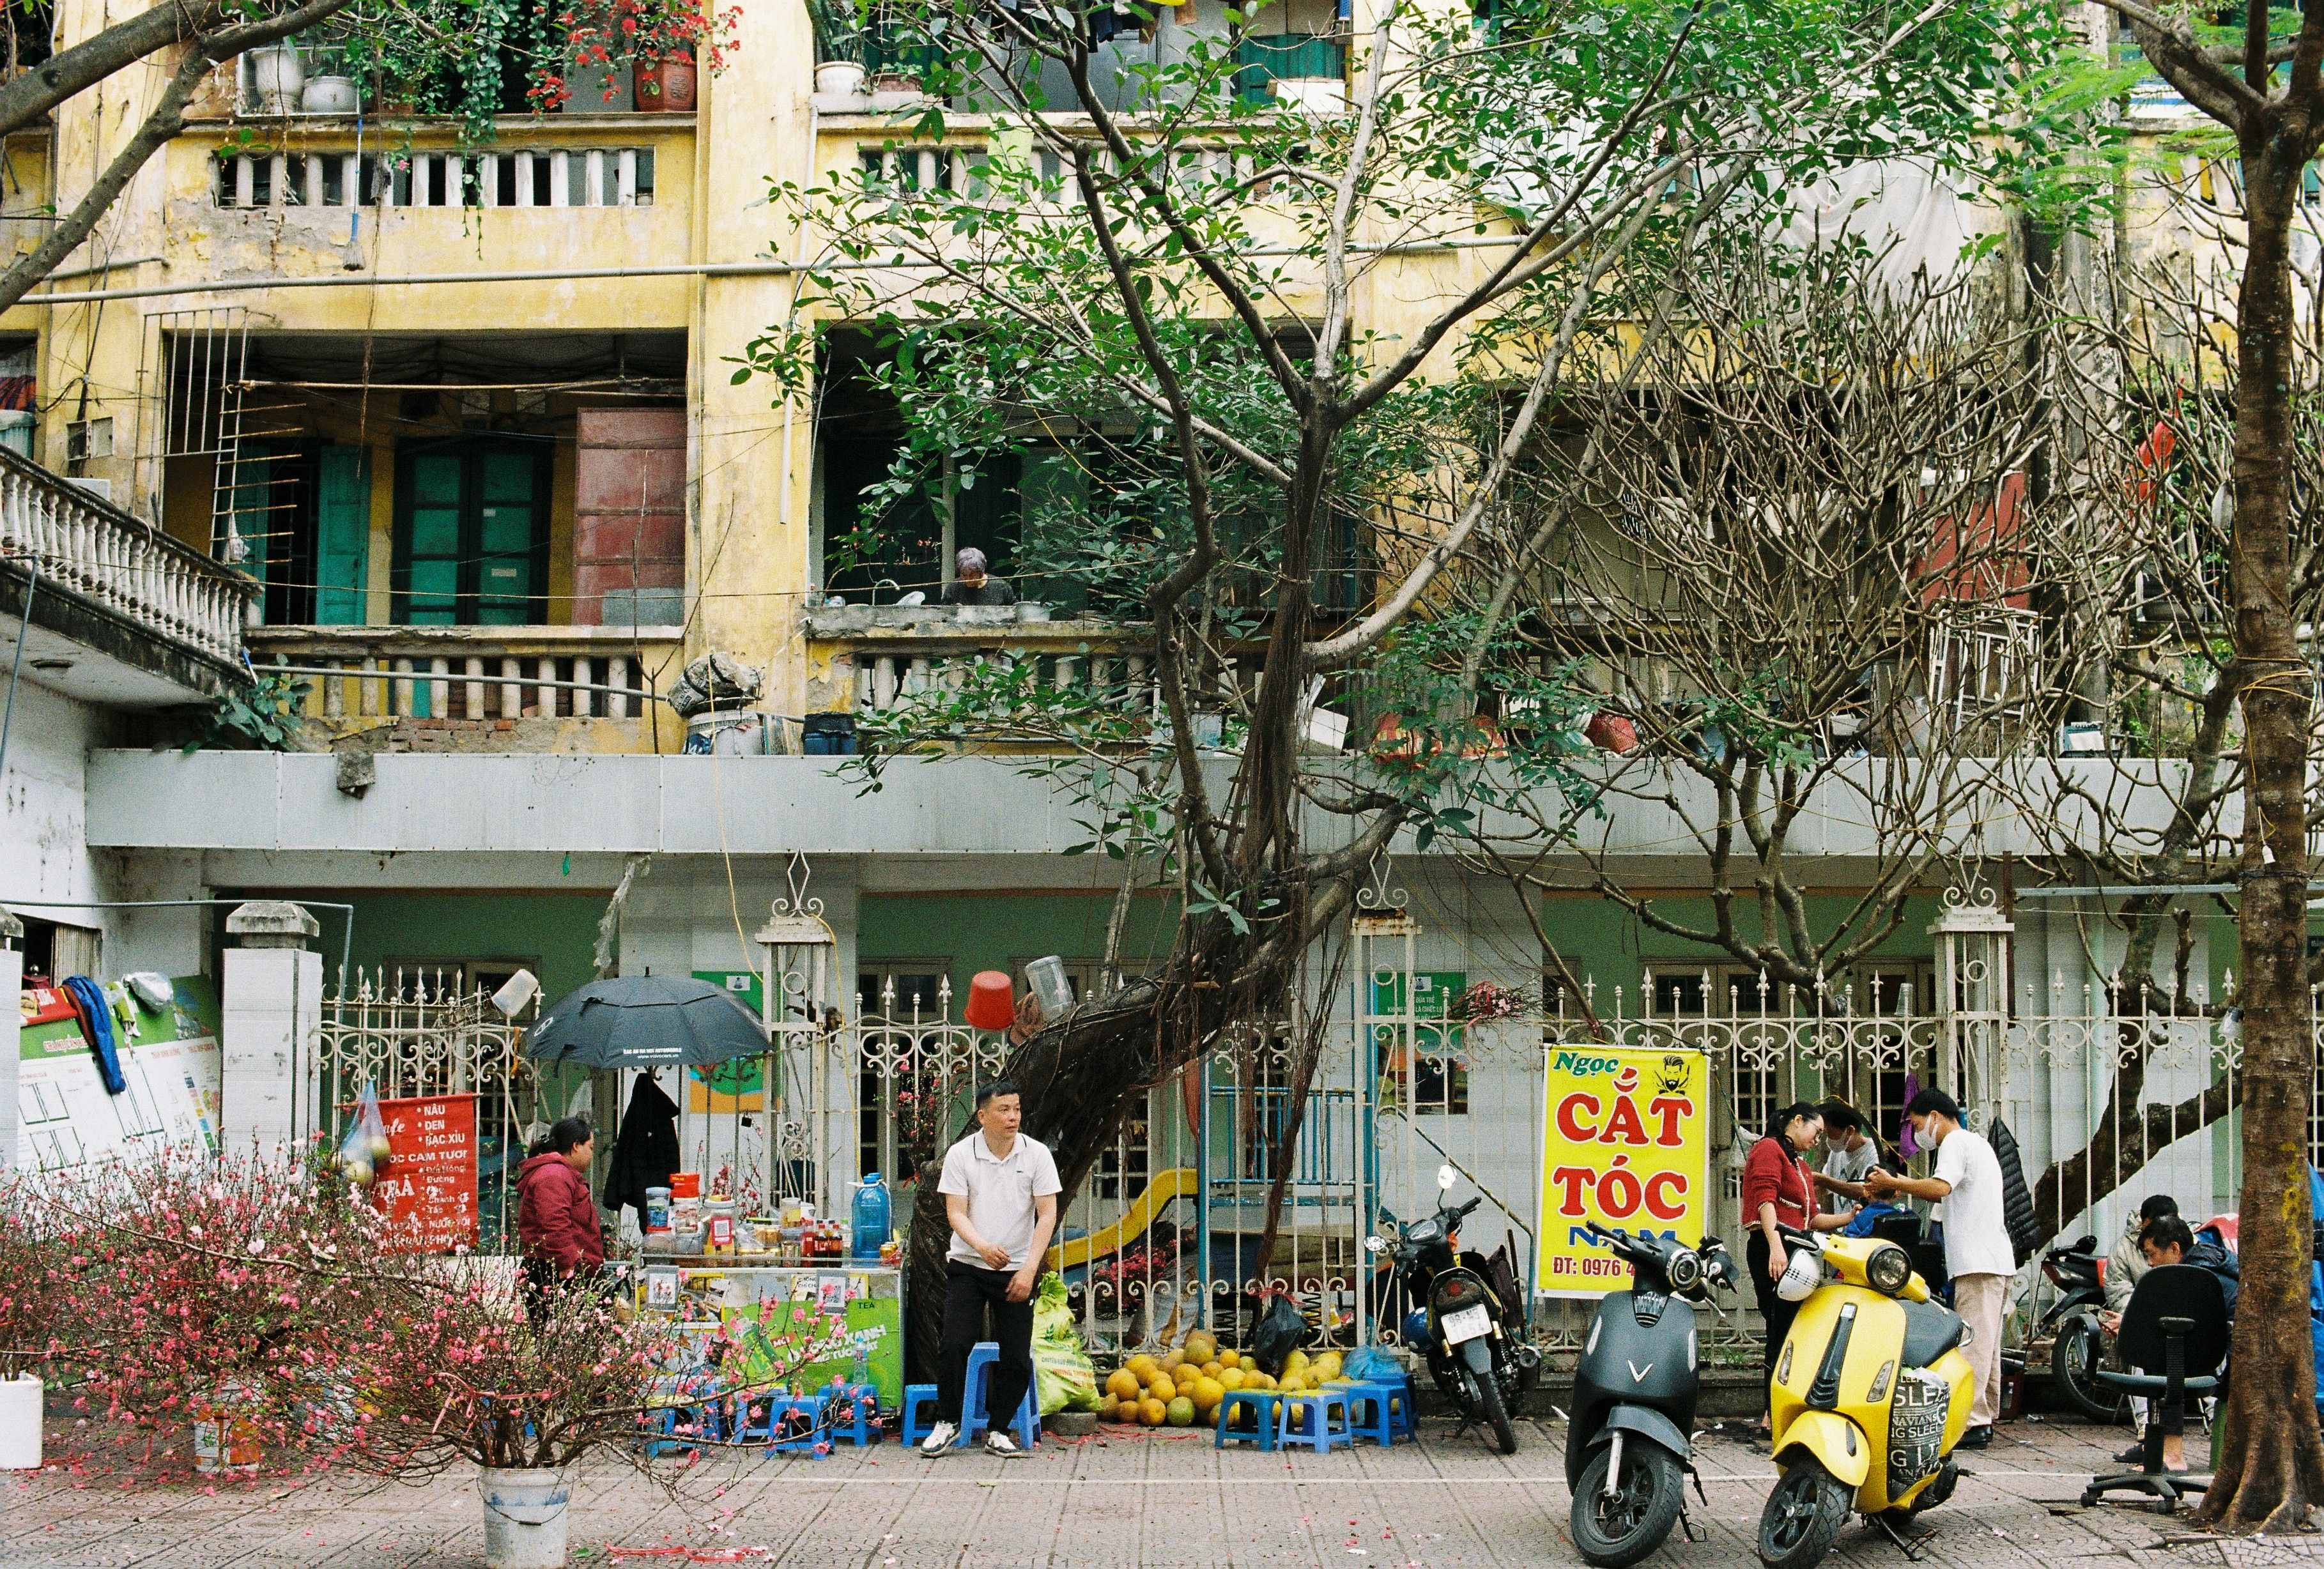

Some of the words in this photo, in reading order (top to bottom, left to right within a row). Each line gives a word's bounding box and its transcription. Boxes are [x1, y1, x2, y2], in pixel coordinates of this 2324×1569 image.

[1553, 1052, 1619, 1076] Ngọc
[424, 1104, 445, 1116] NÂU
[1557, 1067, 1693, 1147] CẮT
[383, 1118, 405, 1137] afe
[408, 1152, 436, 1162] CAM
[1553, 1154, 1688, 1221] TÓC
[1553, 1257, 1577, 1274] ĐT:
[1582, 1258, 1620, 1276] 0976
